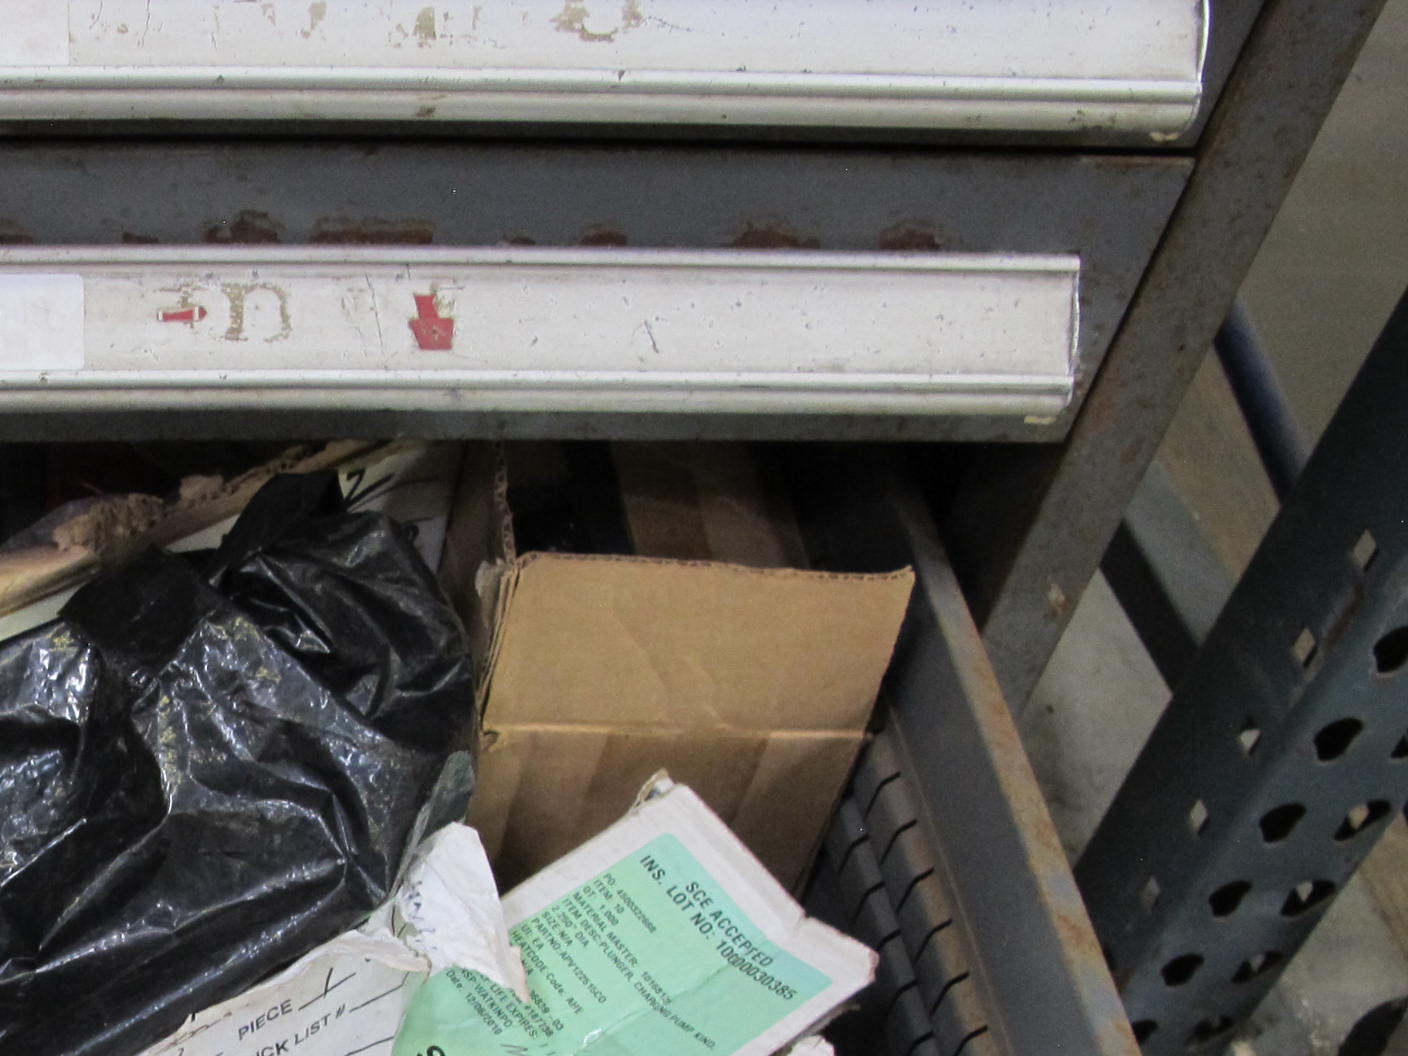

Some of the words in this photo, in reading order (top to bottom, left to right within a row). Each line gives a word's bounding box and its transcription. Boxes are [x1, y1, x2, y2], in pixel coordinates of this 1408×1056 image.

[639, 855, 666, 886] INS.
[666, 885, 695, 912] LOT
[689, 911, 716, 941] NO:
[685, 880, 713, 910] SCE
[237, 998, 293, 1041] PIECE
[293, 1012, 332, 1046] LIST
